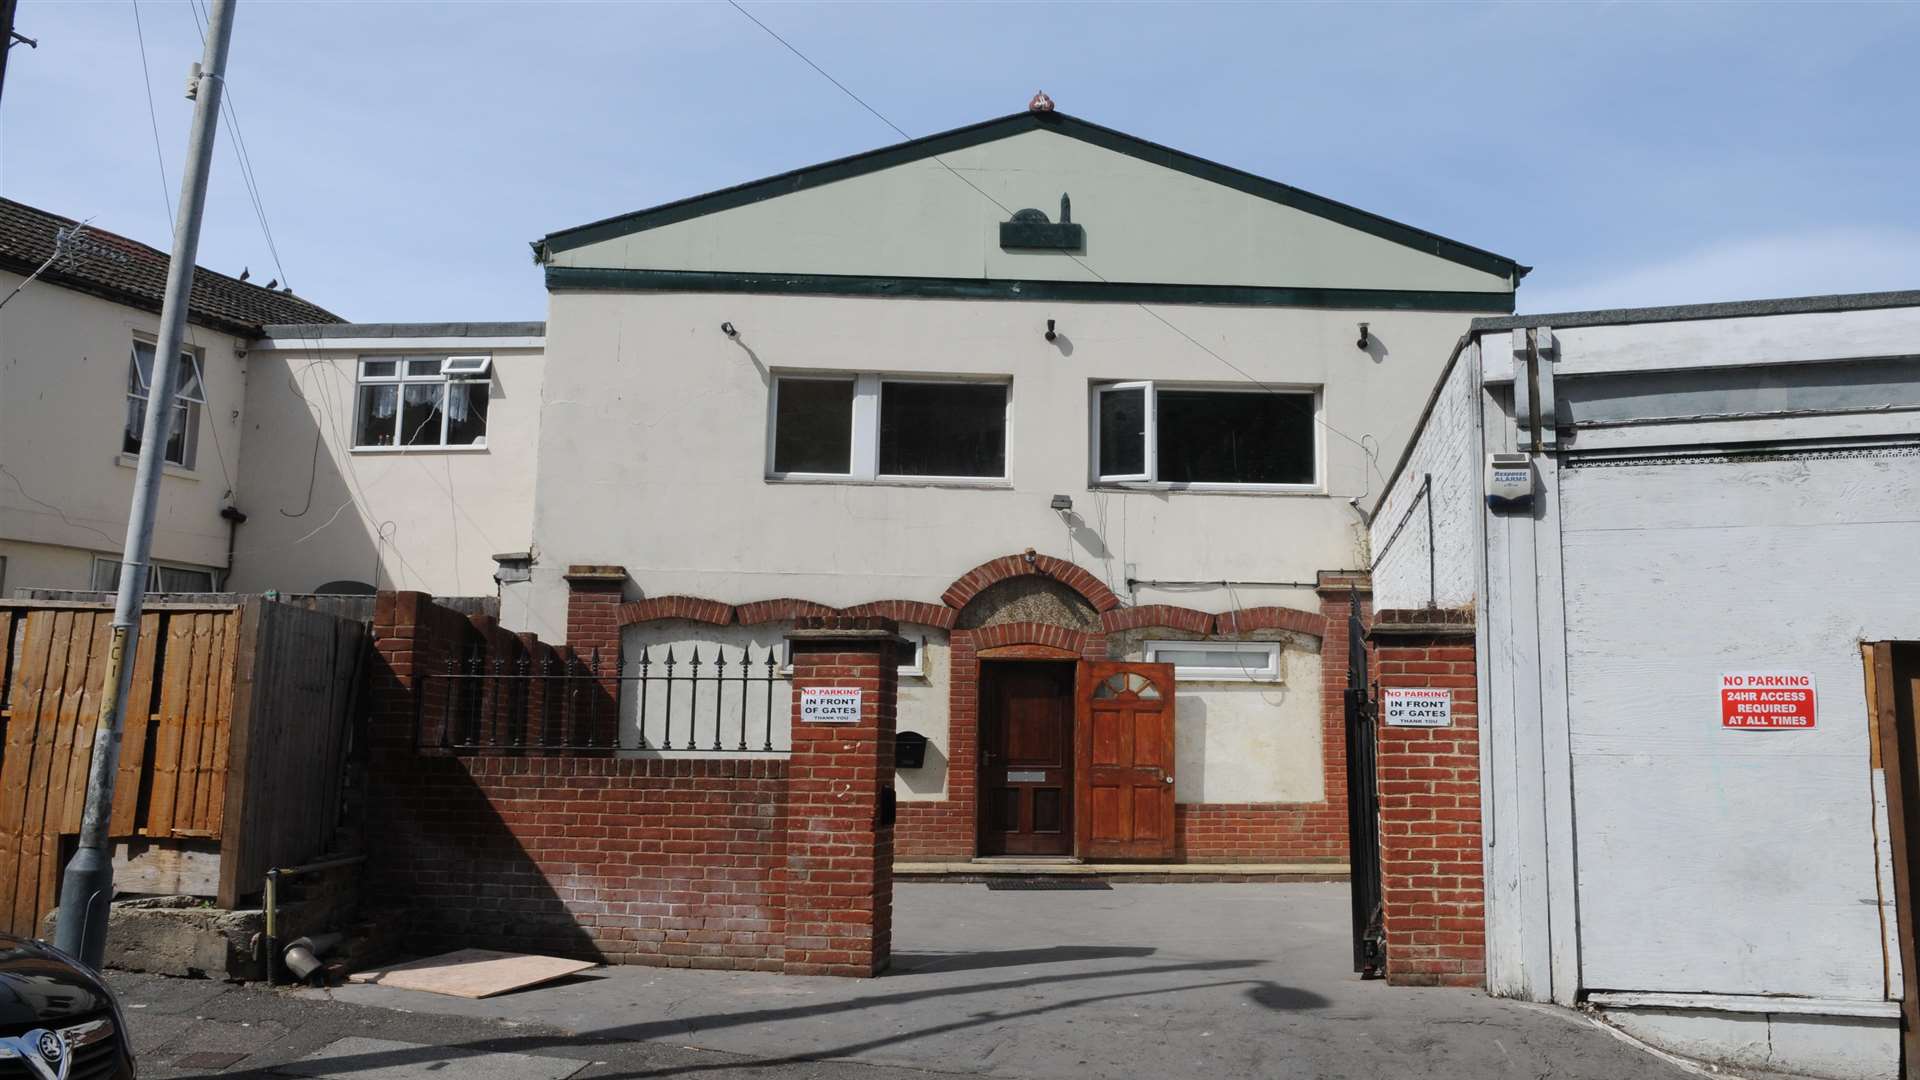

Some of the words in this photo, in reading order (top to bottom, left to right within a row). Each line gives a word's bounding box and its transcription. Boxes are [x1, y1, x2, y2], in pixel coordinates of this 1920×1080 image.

[1723, 676, 1743, 686] NO
[1748, 676, 1809, 686] PARKING
[1727, 692, 1757, 701] 24HR
[1760, 692, 1806, 701] ACCESS
[1737, 704, 1797, 713] REQUIRED
[1728, 716, 1744, 725] AT
[1746, 716, 1768, 725] ALL
[1770, 716, 1807, 725] TIMES
